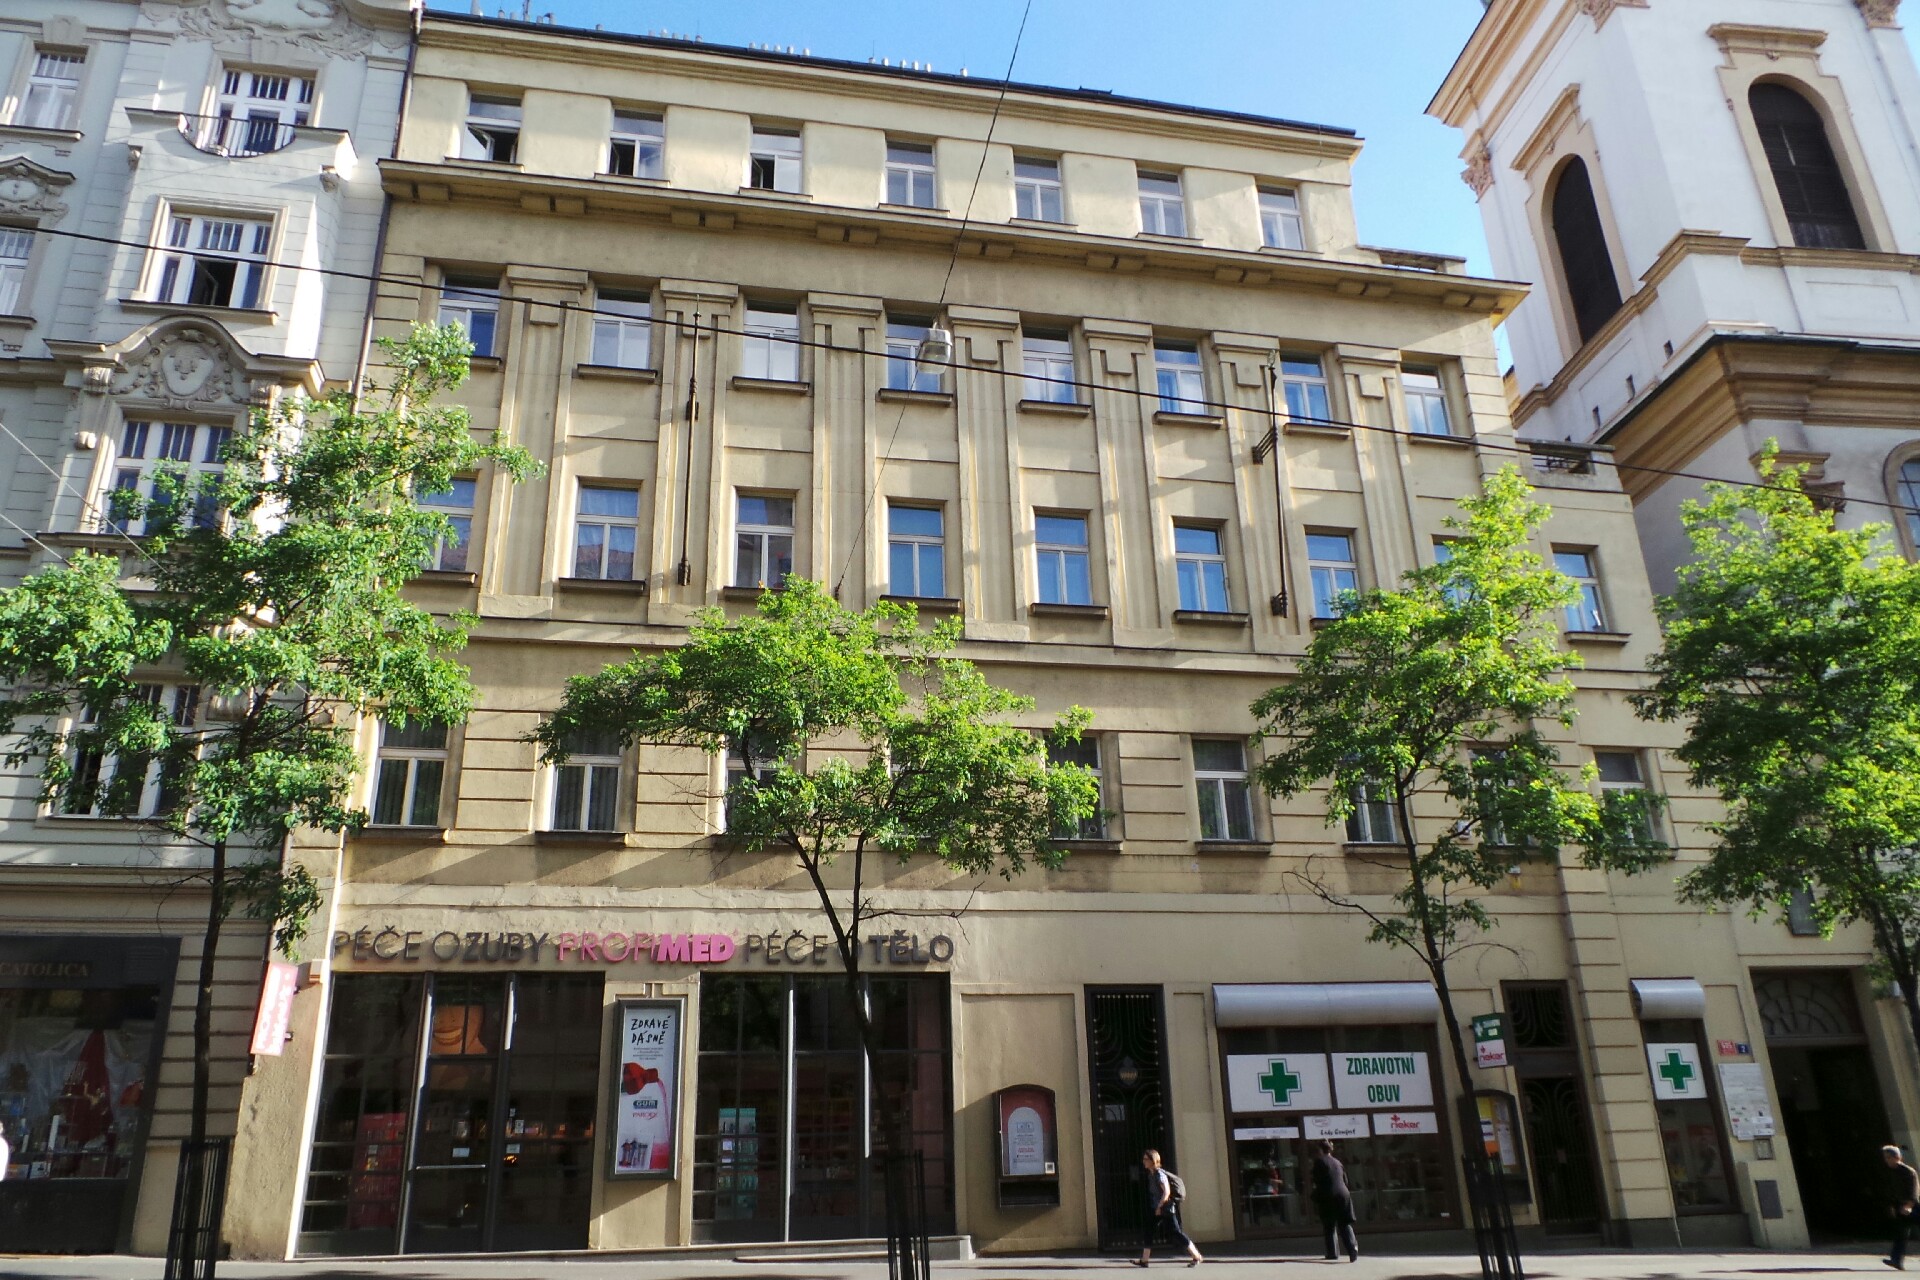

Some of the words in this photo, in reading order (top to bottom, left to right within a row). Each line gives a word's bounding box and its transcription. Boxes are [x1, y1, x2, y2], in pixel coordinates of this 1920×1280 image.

[332, 924, 422, 961] PÉČE
[558, 932, 735, 963] PROFIMED
[743, 929, 829, 964] PÉČE
[868, 929, 954, 964] TĚLO
[630, 1015, 672, 1030] ZDRAVÉ
[631, 1030, 666, 1045] DÁSNĚ
[1346, 1052, 1415, 1075] ZDRAVOTNÍ
[1368, 1085, 1400, 1103] OBUV
